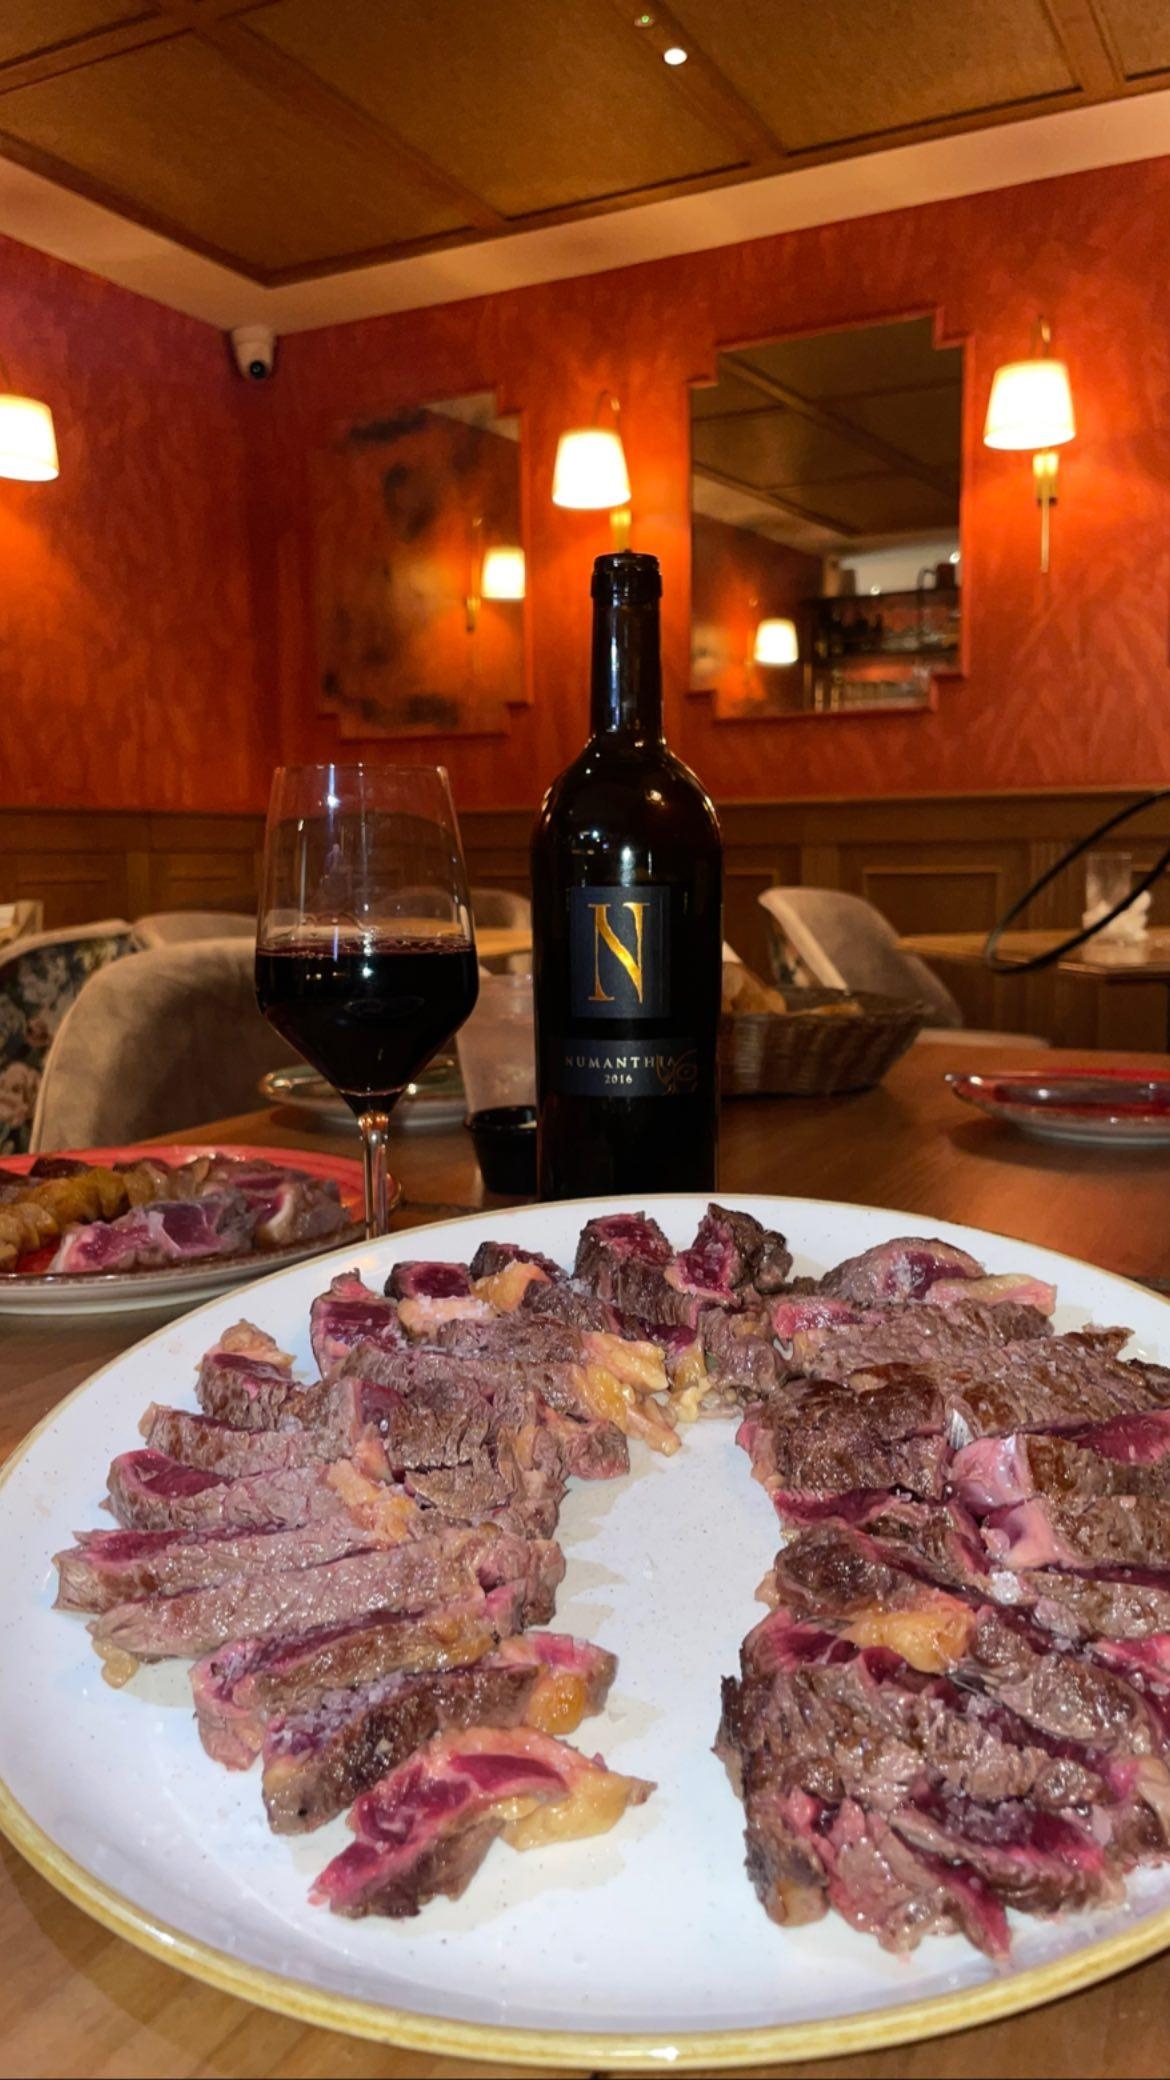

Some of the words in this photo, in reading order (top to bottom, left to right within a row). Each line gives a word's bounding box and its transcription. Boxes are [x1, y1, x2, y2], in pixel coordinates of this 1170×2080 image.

[587, 902, 651, 1003] N
[564, 1055, 676, 1069] NUMANTHIA
[604, 1073, 633, 1085] 2016
